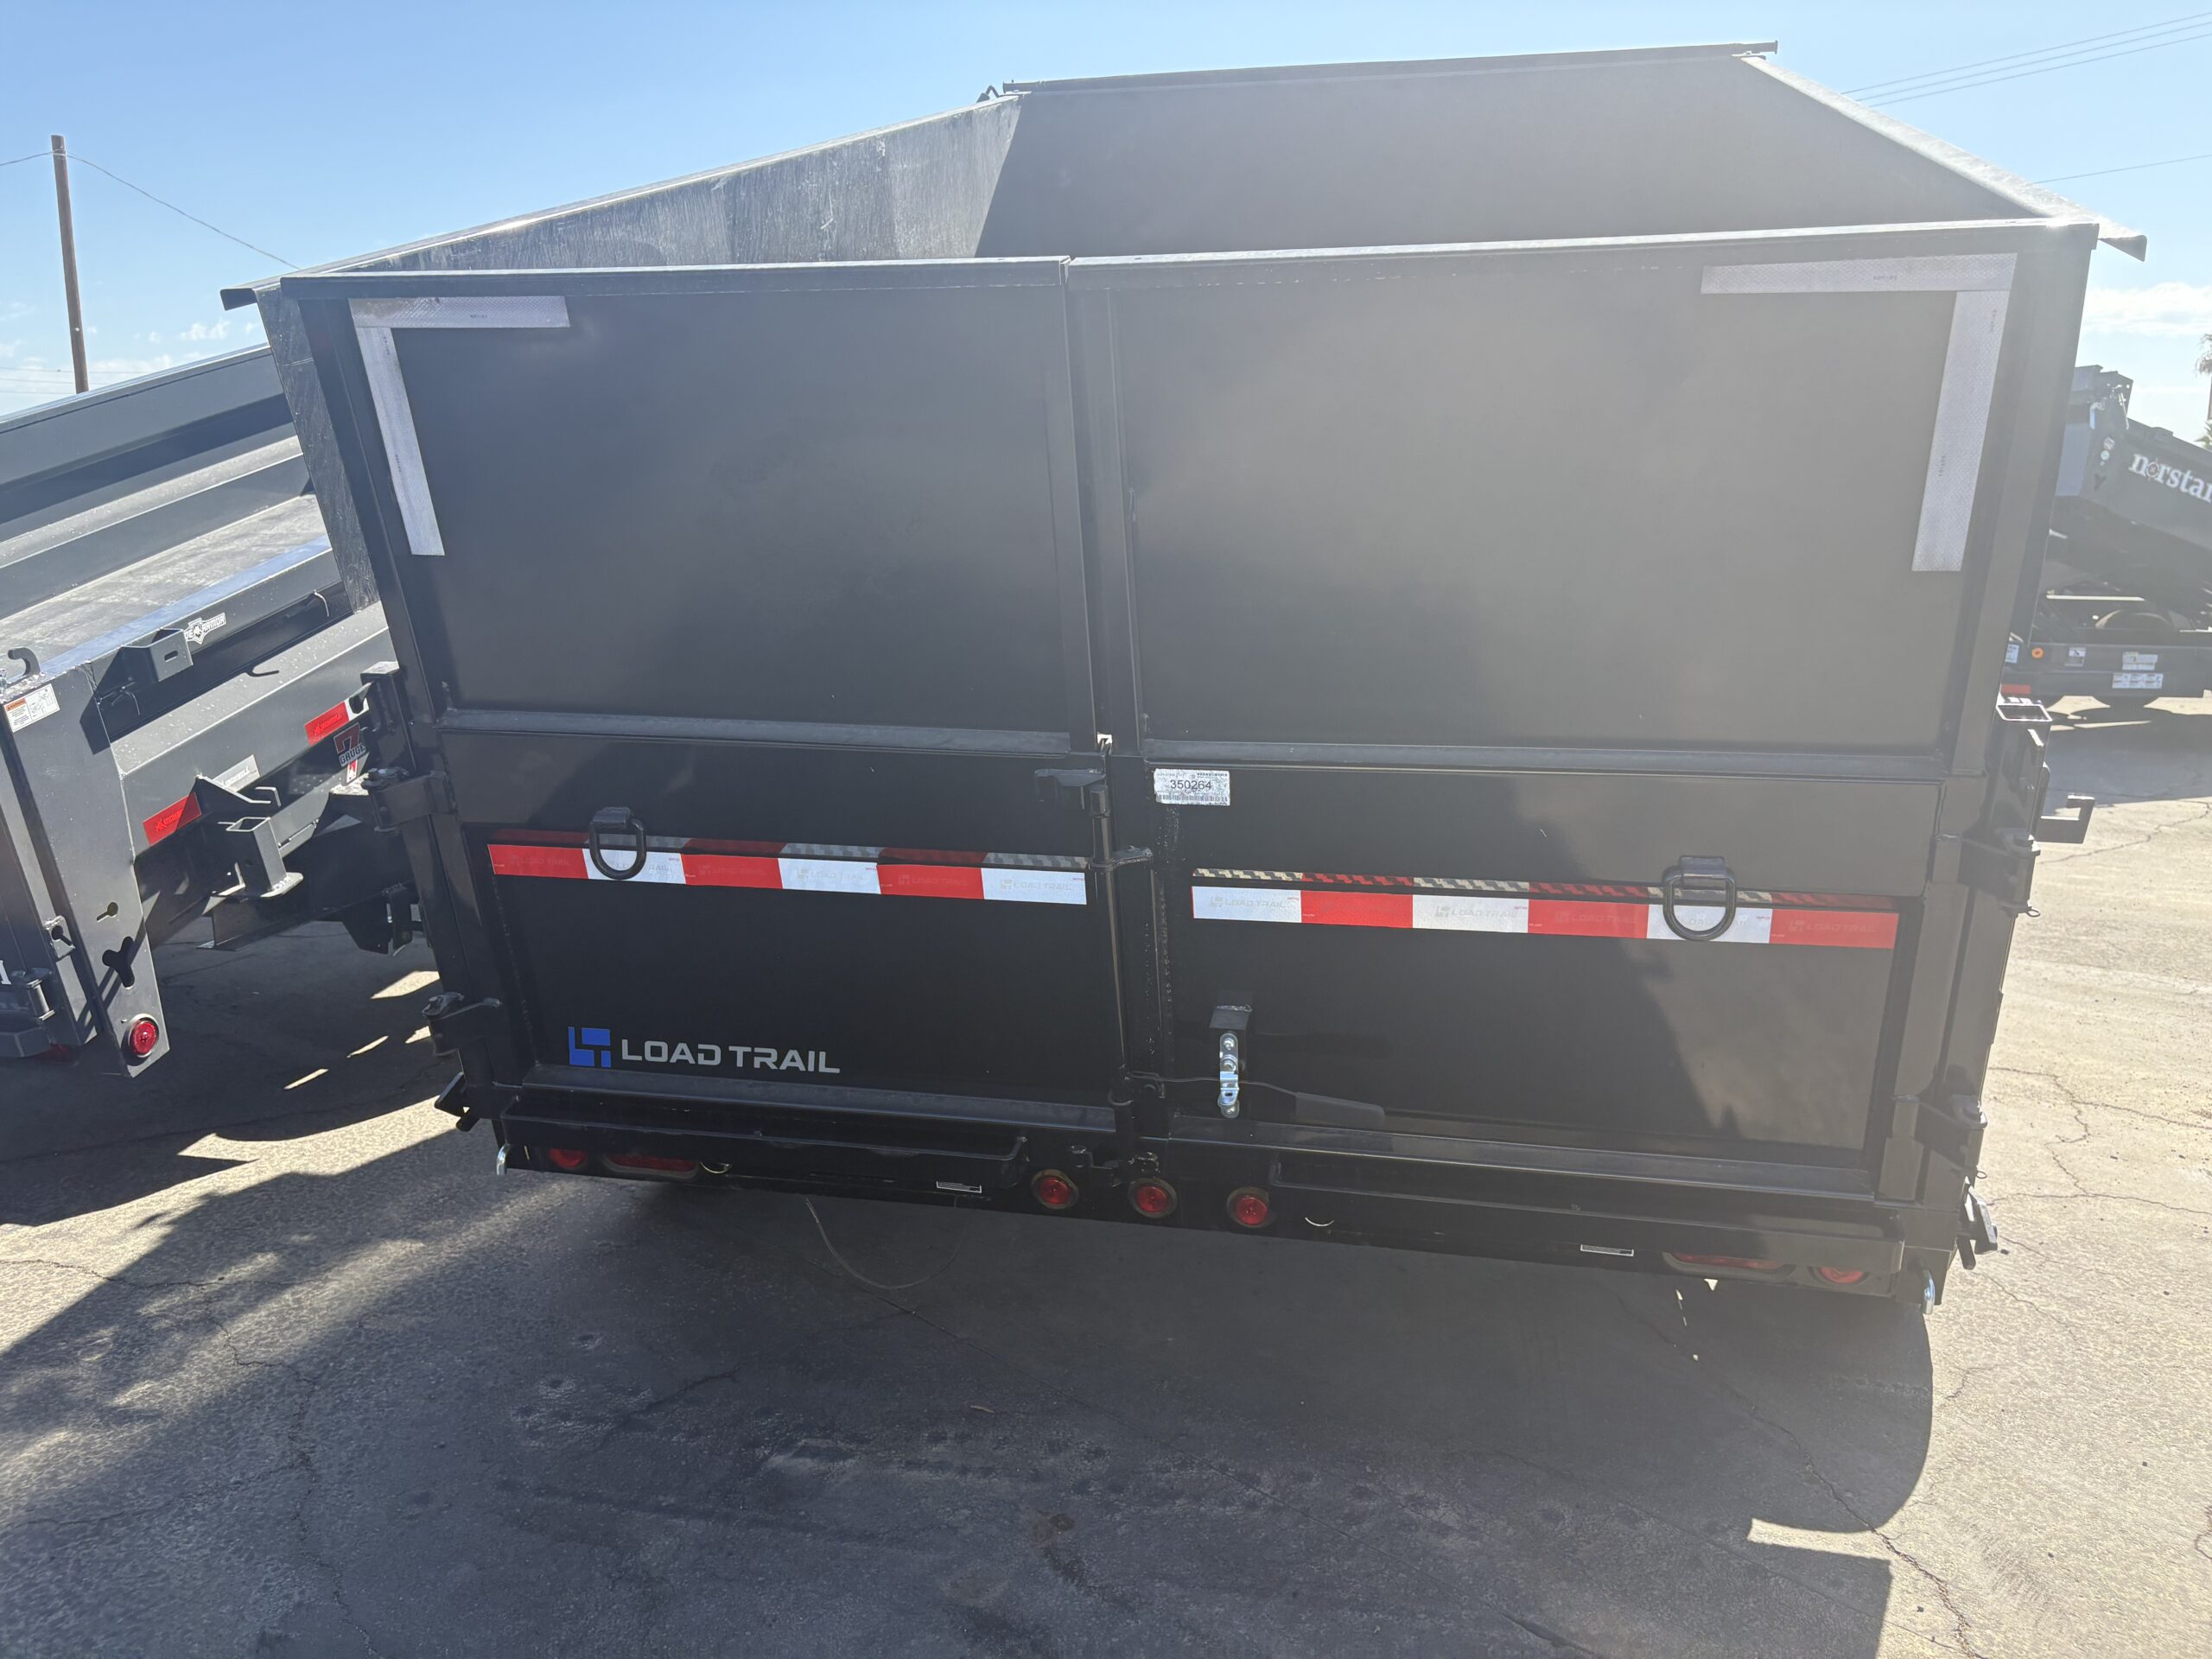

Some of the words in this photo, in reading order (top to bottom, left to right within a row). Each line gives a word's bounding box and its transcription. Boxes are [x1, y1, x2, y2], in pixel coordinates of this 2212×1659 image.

[2128, 454, 2212, 503] norstar
[201, 614, 225, 632] ARMOR
[334, 722, 360, 753] 7
[339, 743, 366, 767] GAUGE
[1170, 780, 1211, 790] 350264
[621, 1039, 721, 1065] LOAD
[728, 1046, 841, 1073] TRAIL
